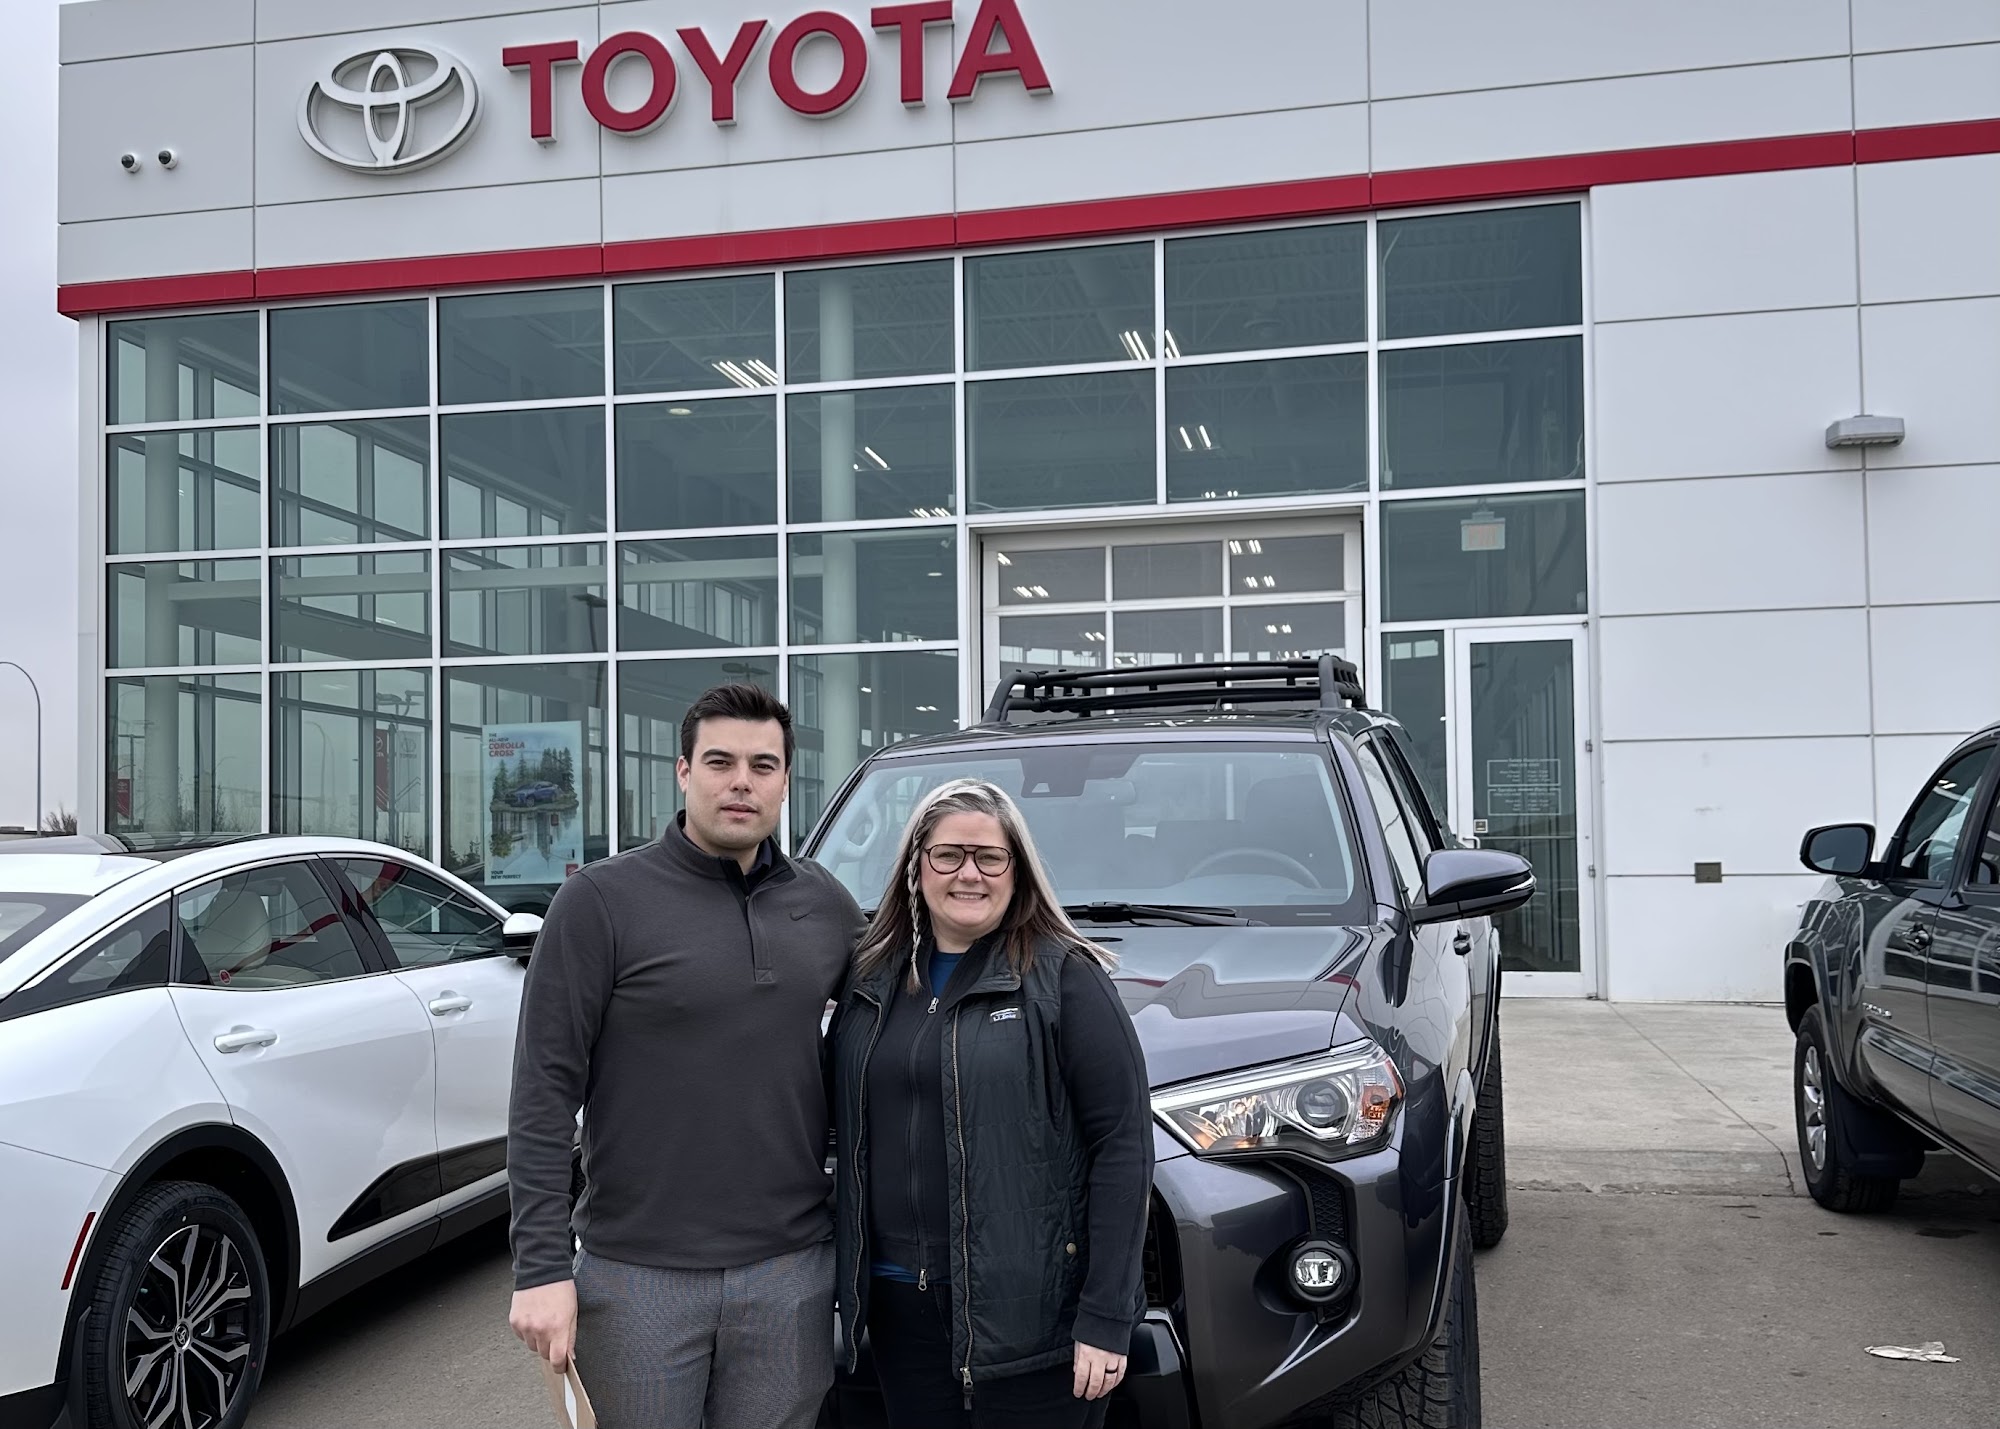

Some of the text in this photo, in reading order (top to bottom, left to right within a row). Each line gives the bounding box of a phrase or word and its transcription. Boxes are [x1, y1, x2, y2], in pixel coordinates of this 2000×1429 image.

[502, 0, 1053, 141] TOYOTA
[489, 741, 525, 750] COROLLA
[489, 749, 515, 757] CROSS
